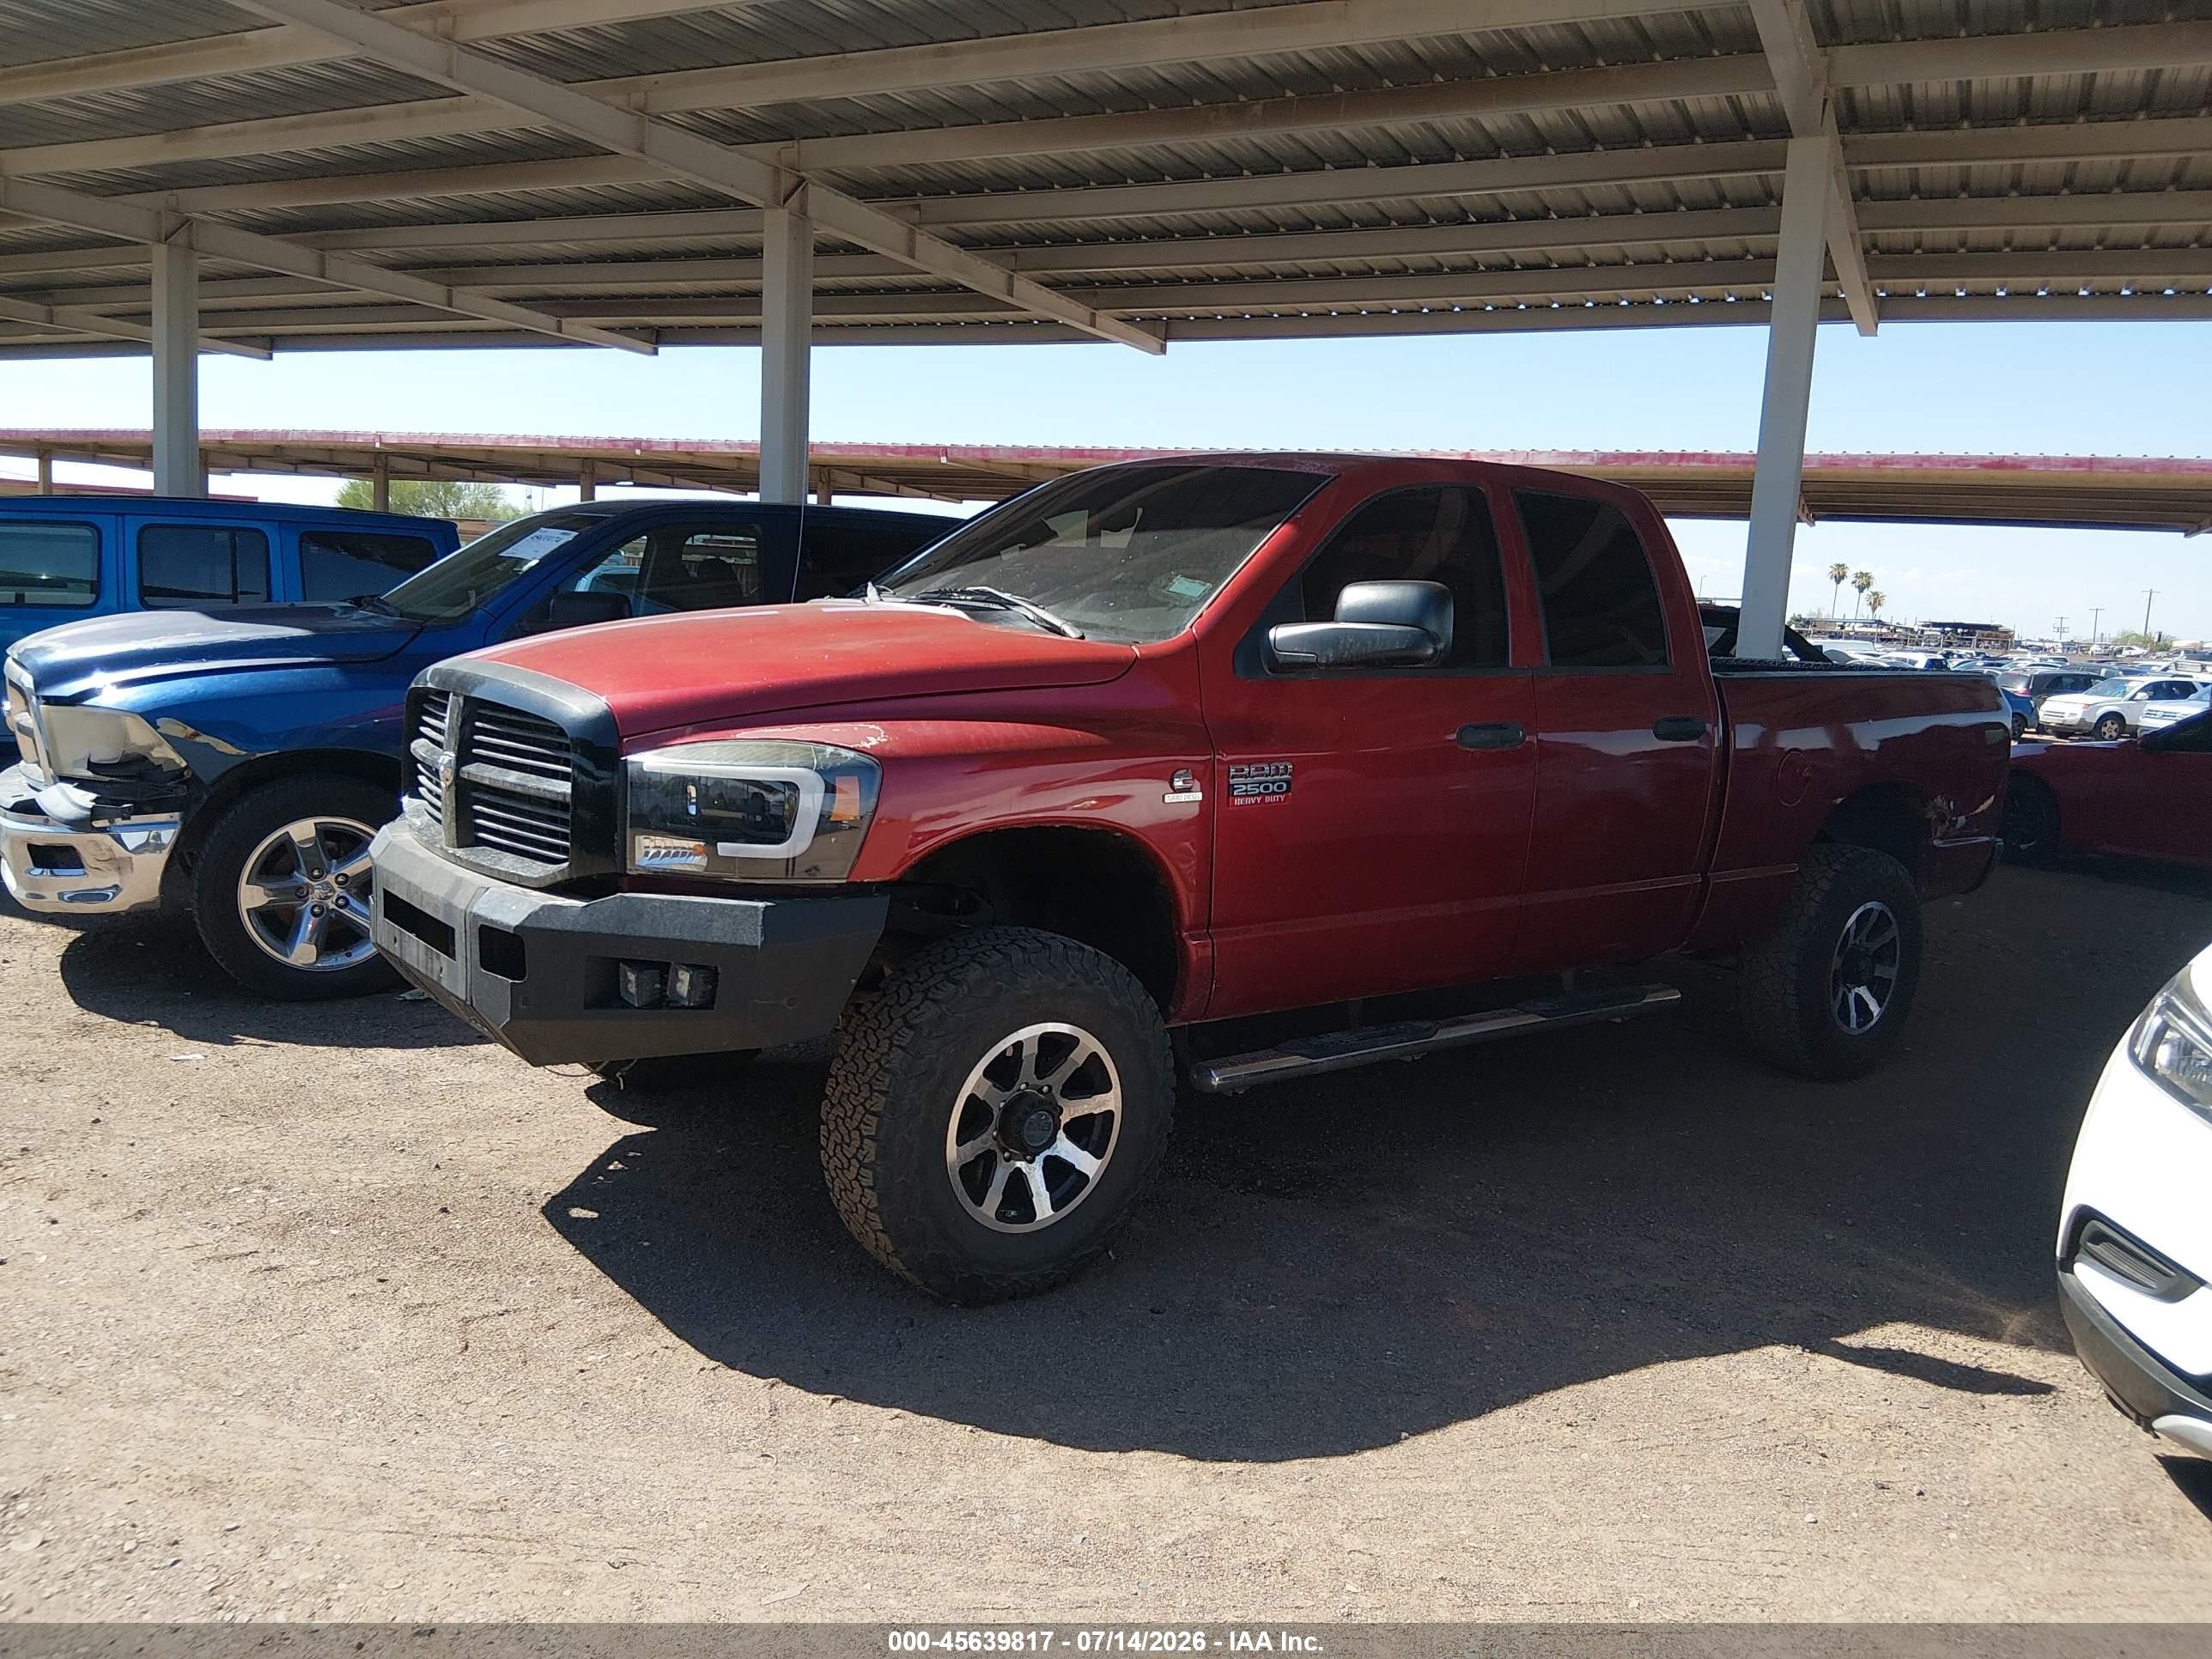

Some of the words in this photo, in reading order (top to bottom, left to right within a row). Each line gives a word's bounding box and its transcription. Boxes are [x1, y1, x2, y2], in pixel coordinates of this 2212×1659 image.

[1230, 762, 1292, 780] RAM
[1233, 782, 1287, 796] 2500
[1234, 796, 1262, 805] HEAVY
[1265, 794, 1285, 803] DUTY
